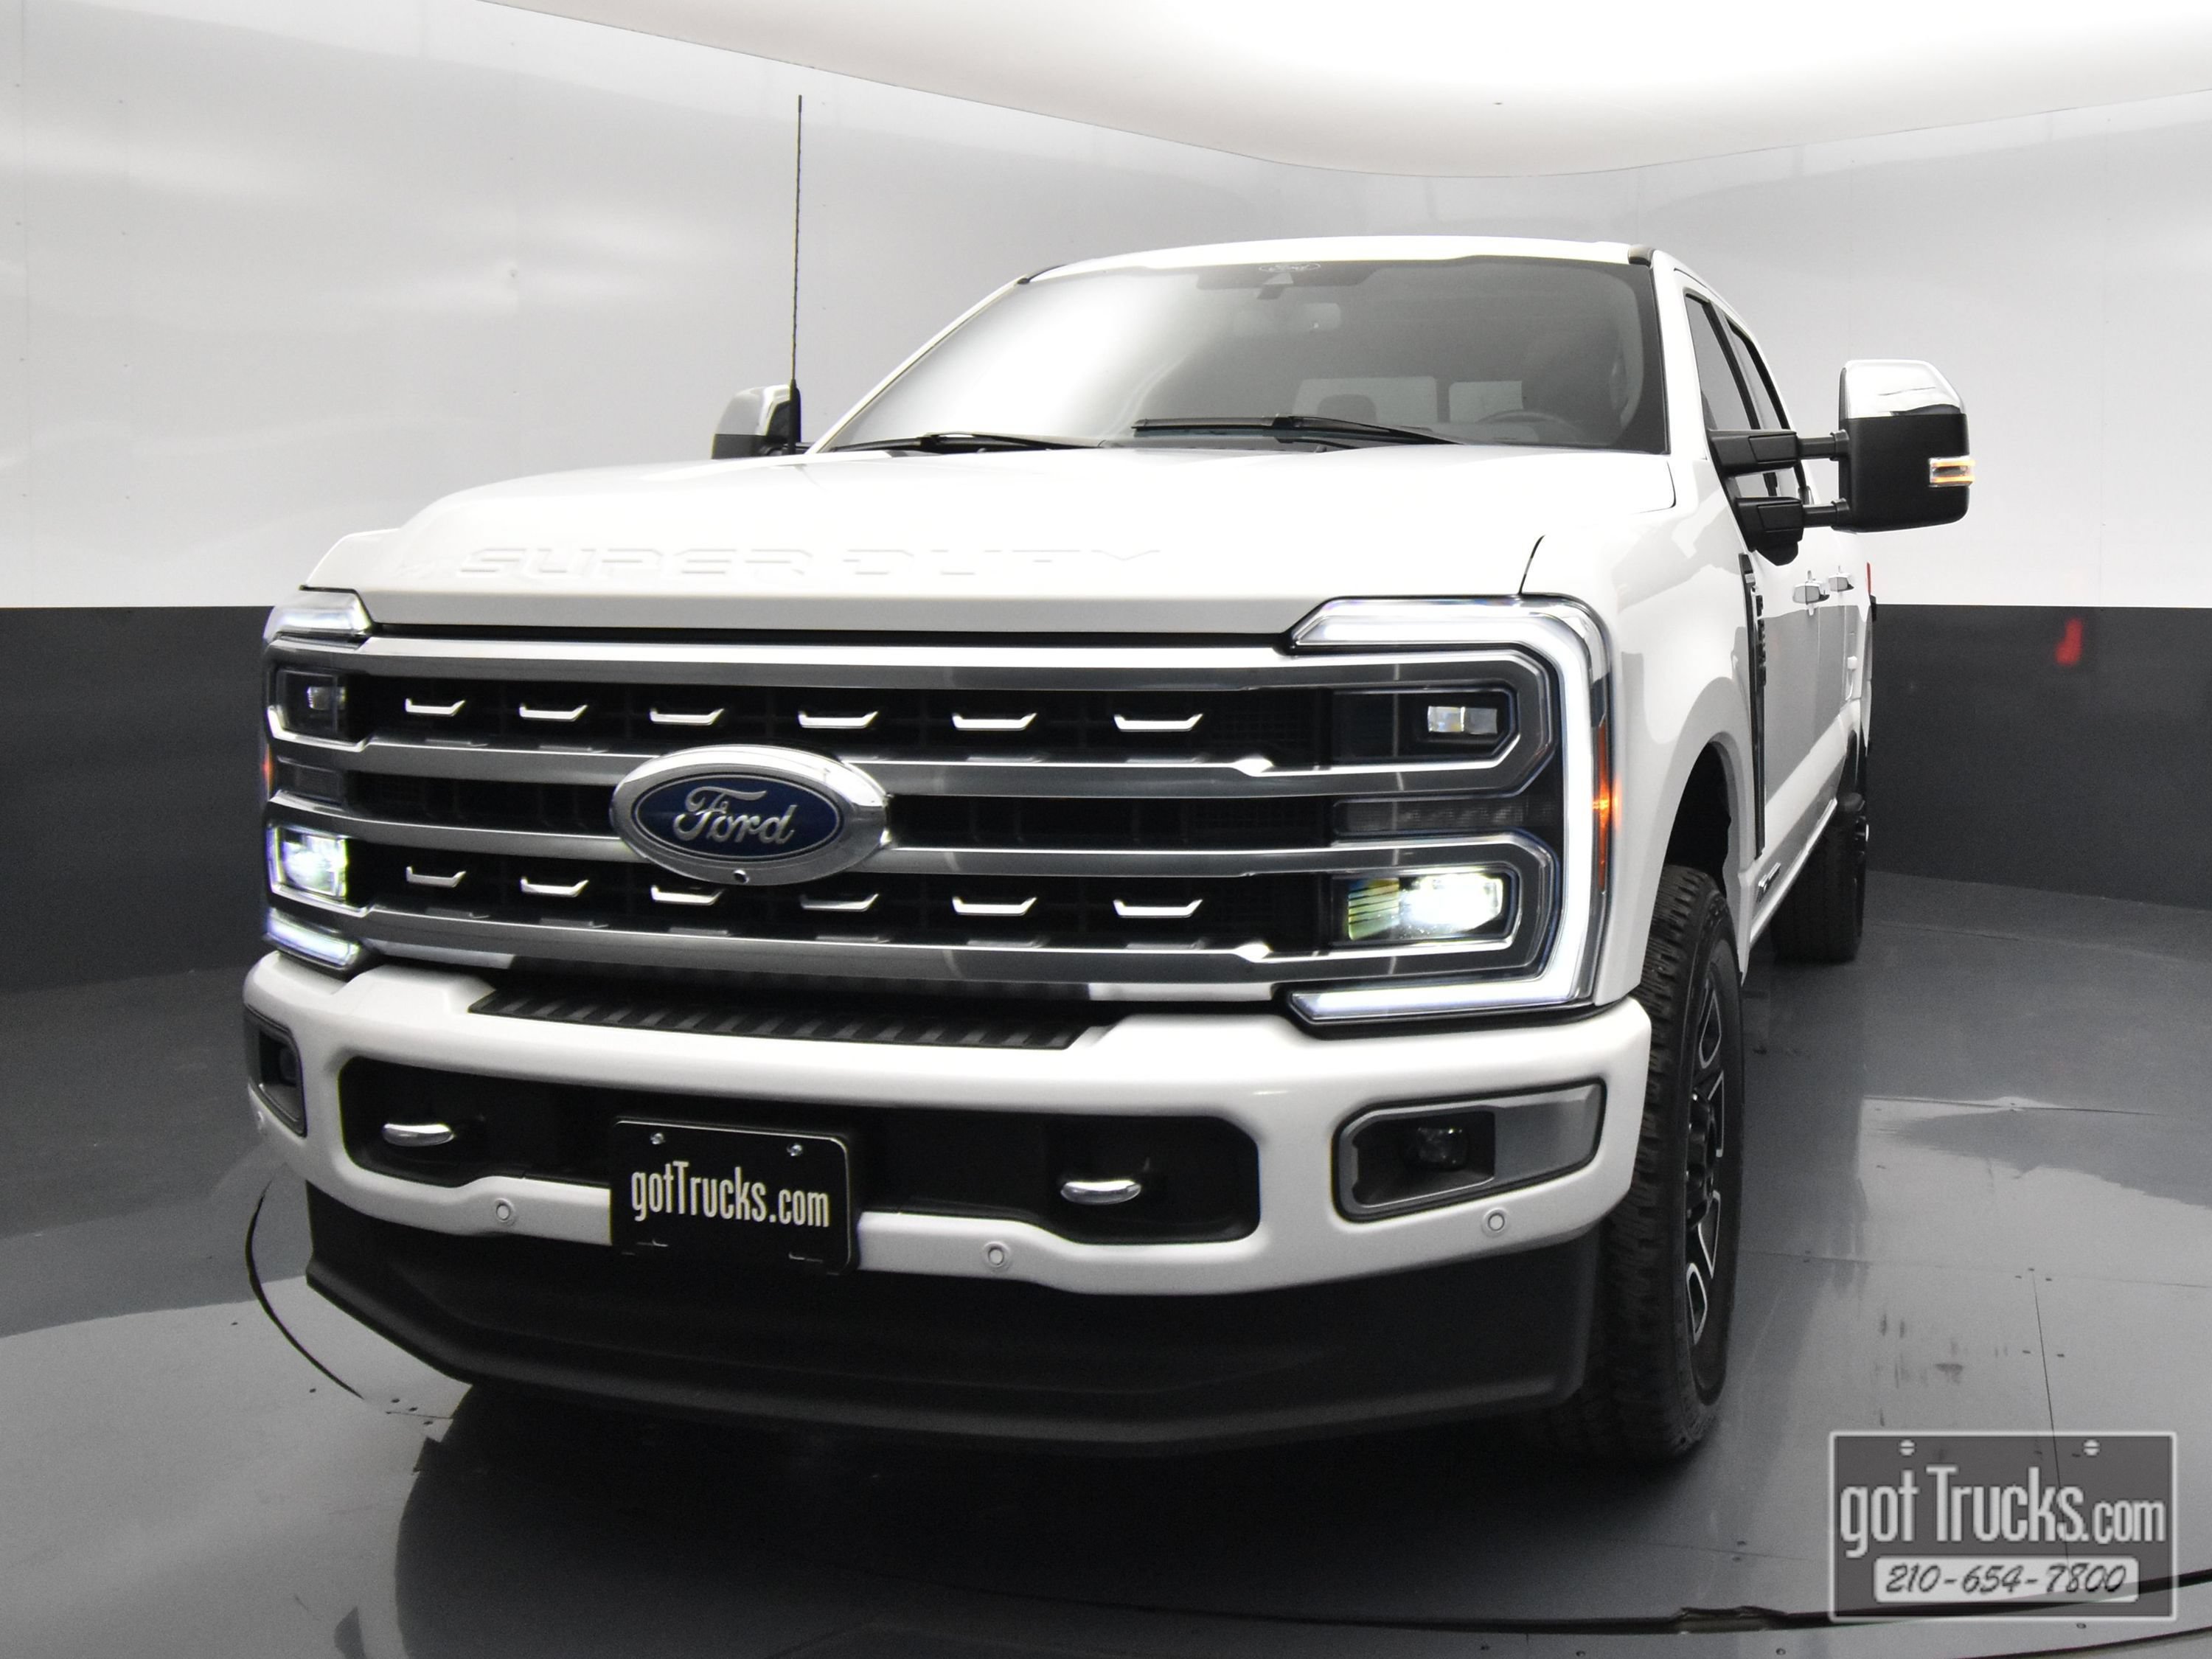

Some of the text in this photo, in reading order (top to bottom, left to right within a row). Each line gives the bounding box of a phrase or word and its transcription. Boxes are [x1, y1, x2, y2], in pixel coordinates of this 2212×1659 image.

[457, 546, 1161, 577] SUPER DUTY
[672, 785, 798, 845] Ford
[630, 1160, 830, 1228] gotTrucks.com
